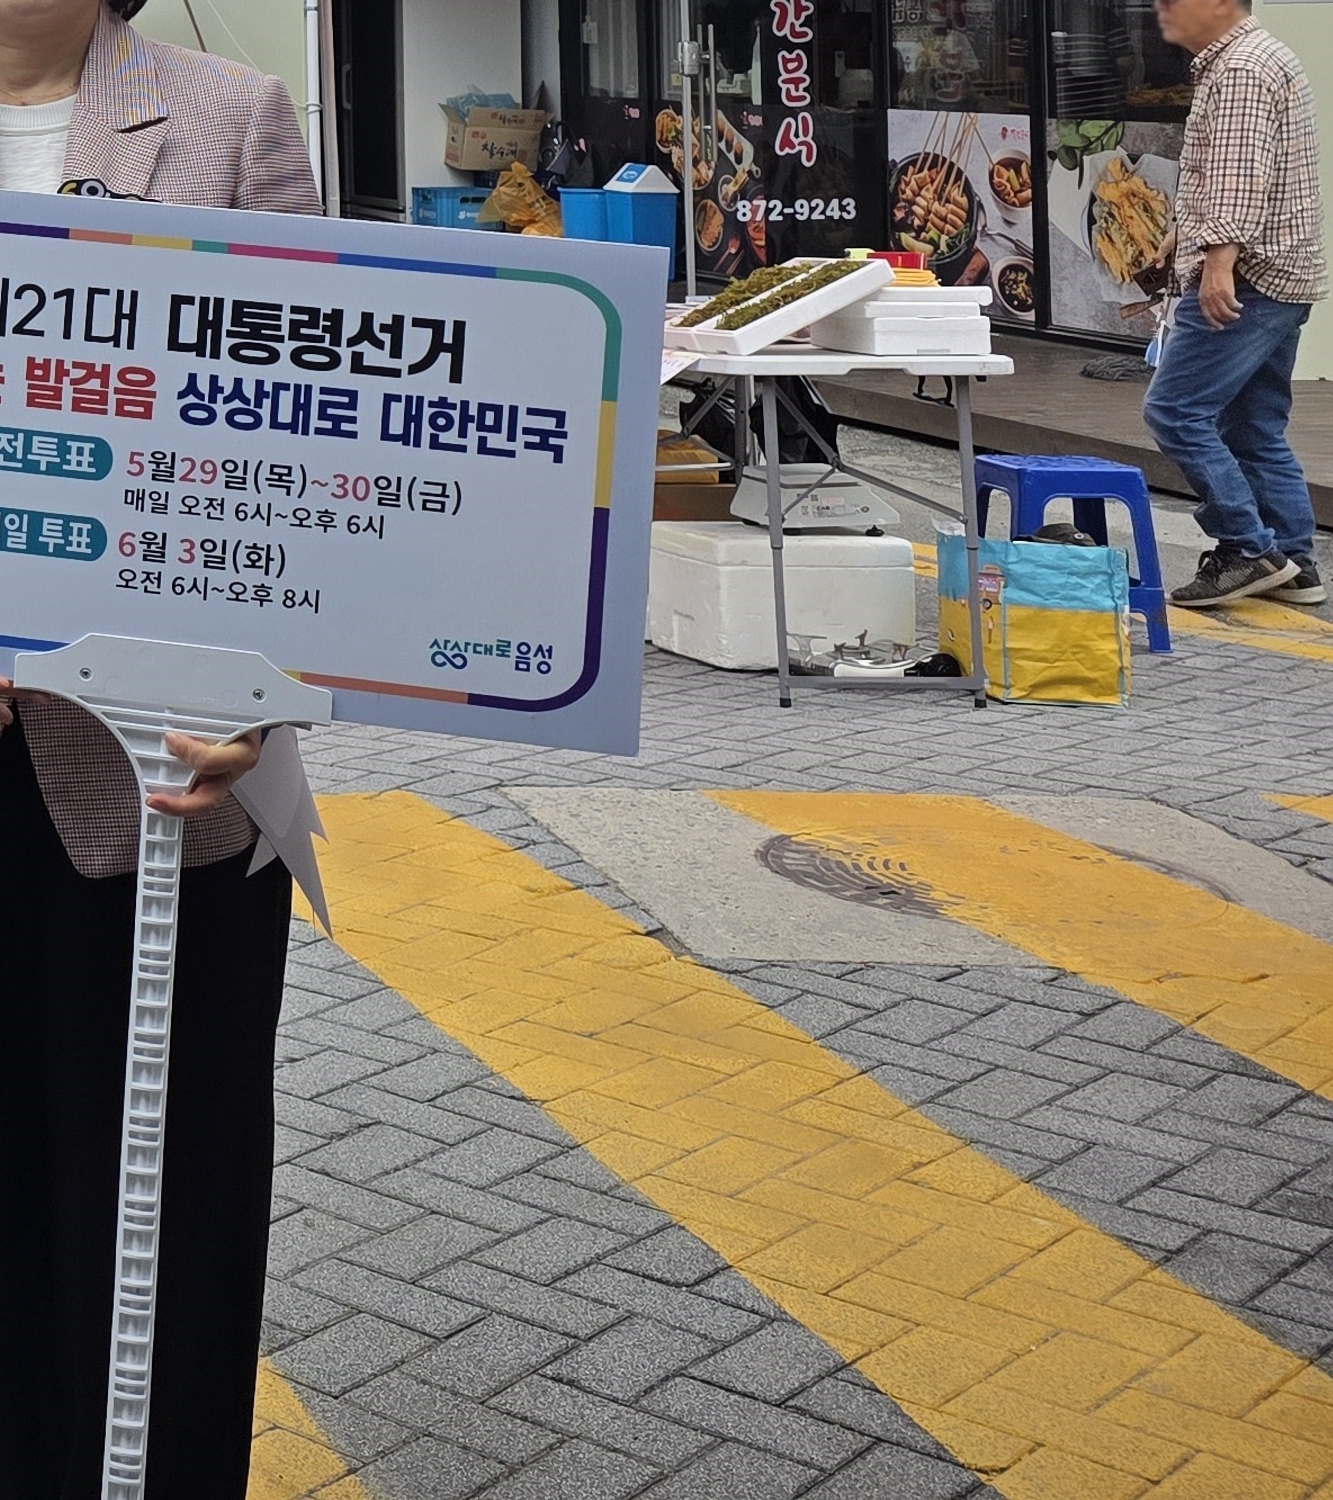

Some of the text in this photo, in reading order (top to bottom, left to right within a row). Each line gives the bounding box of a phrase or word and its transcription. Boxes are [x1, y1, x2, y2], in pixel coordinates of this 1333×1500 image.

[735, 197, 857, 222] 872-9243
[168, 293, 468, 384] 대통령선거
[25, 355, 158, 421] 발걸음
[176, 370, 363, 440] 상상대로
[380, 390, 569, 465] 대한민국
[126, 448, 464, 517] 5월29일(목)~30일(금)
[37, 518, 94, 557] 투표
[123, 488, 386, 541] 매일 오전 6시~오후 6시
[118, 529, 287, 578] 6월 3일(화)
[116, 567, 322, 616] 오전 6시~오후 8시
